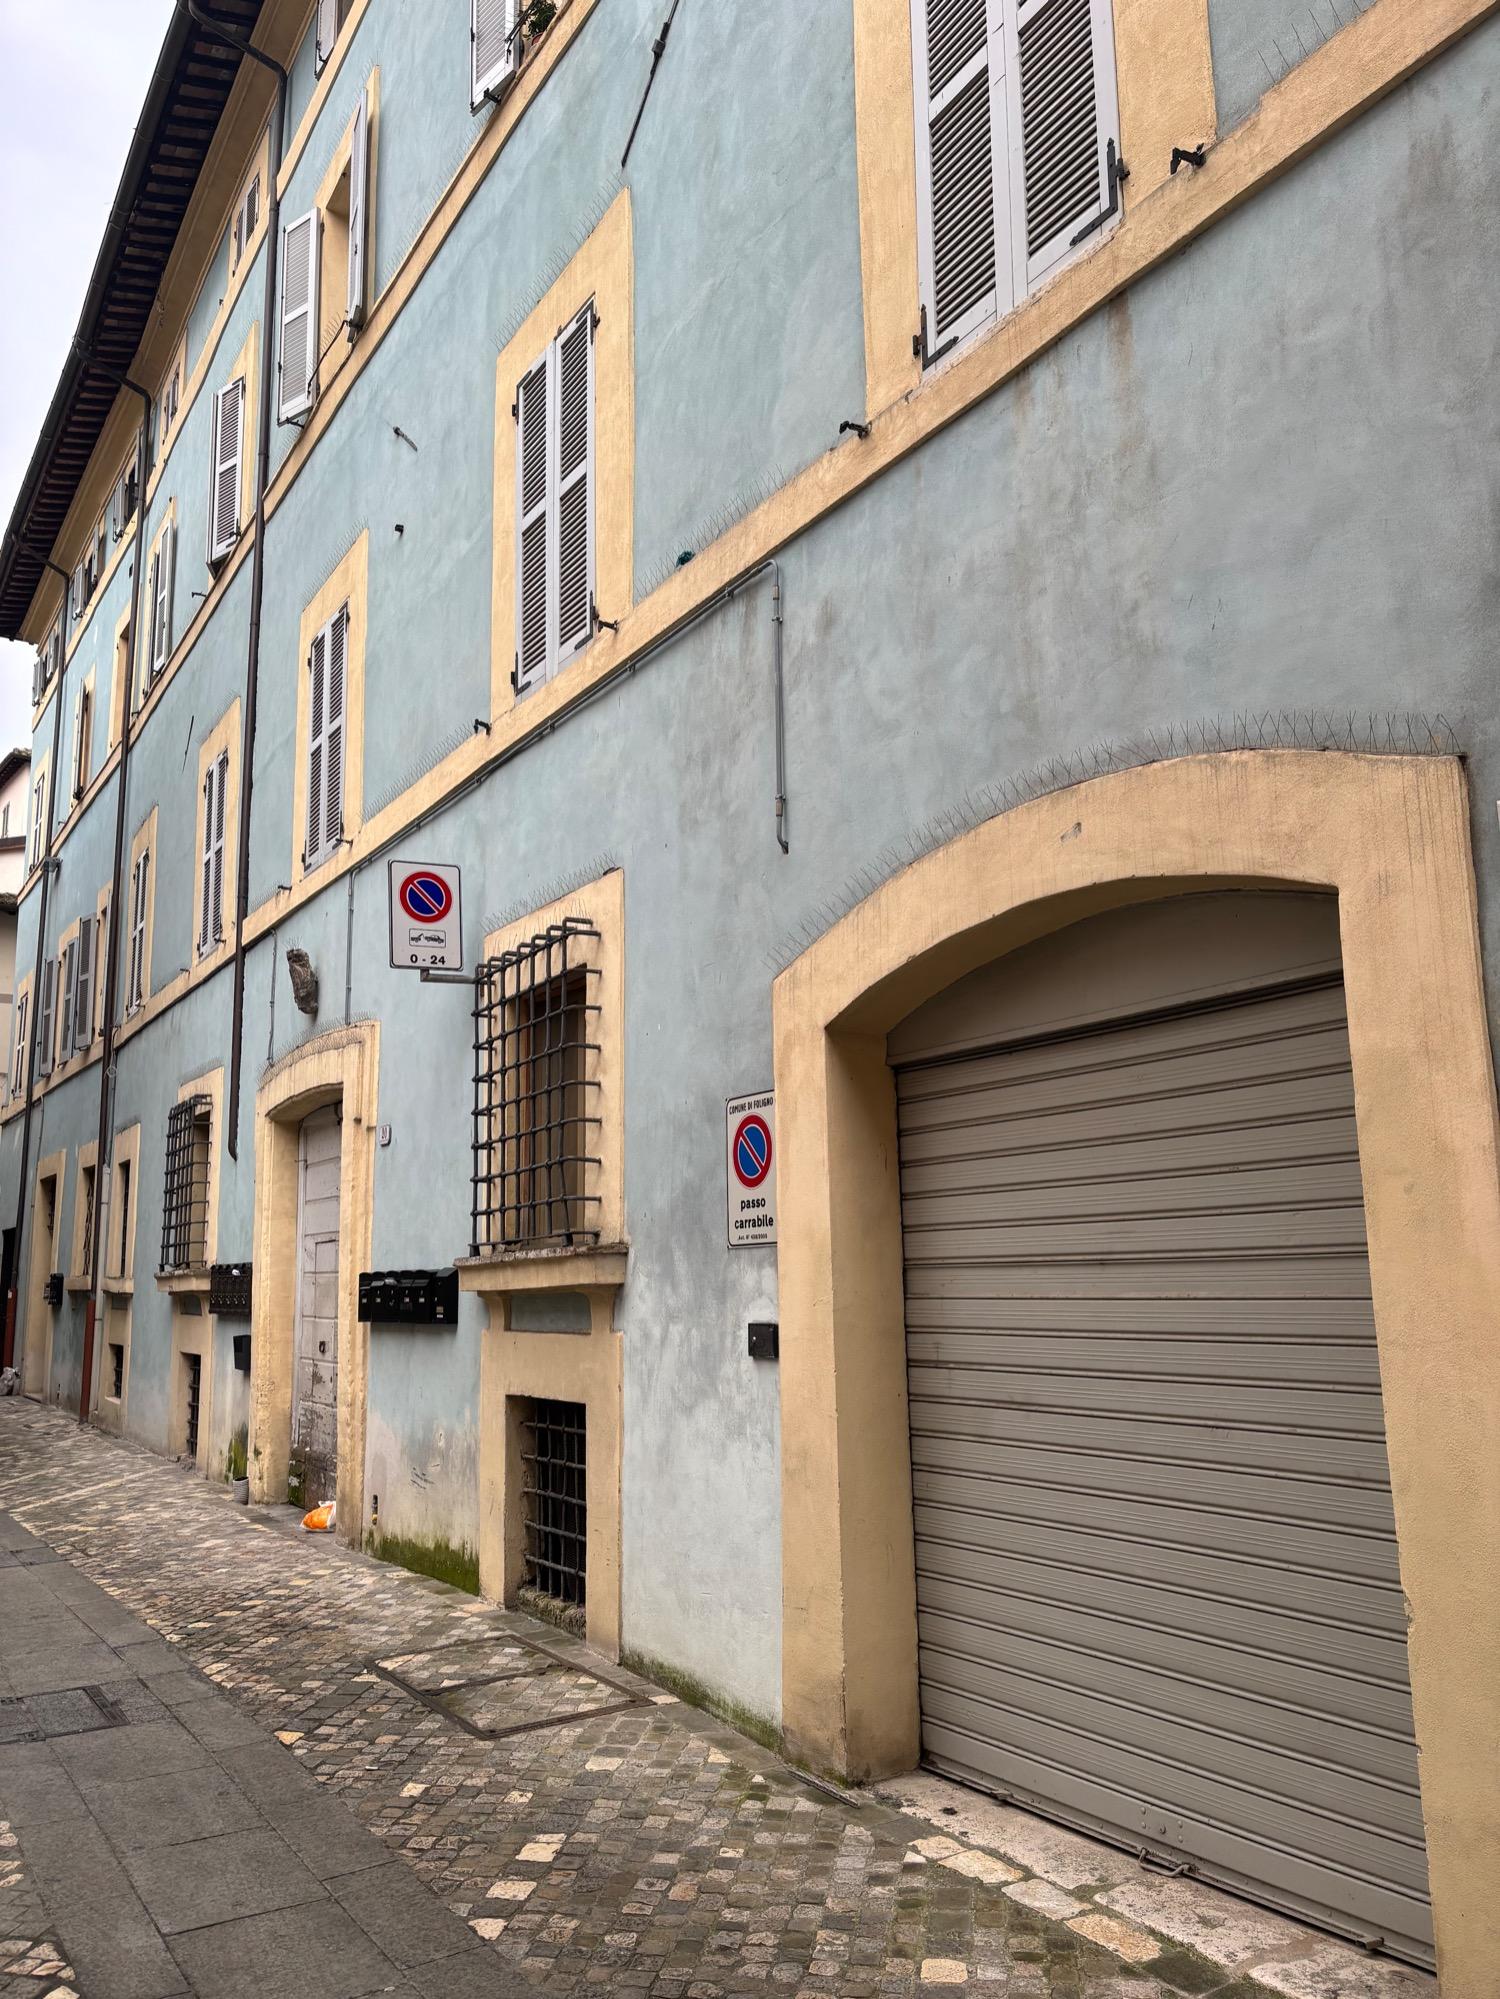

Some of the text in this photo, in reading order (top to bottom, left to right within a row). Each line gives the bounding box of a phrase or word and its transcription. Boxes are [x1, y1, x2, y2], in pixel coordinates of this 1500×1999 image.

[410, 954, 418, 964] 0
[430, 955, 446, 965] 24
[729, 1097, 774, 1115] COMUNE DI FOLIGNO
[741, 1198, 766, 1212] passo
[735, 1214, 774, 1229] carrabile
